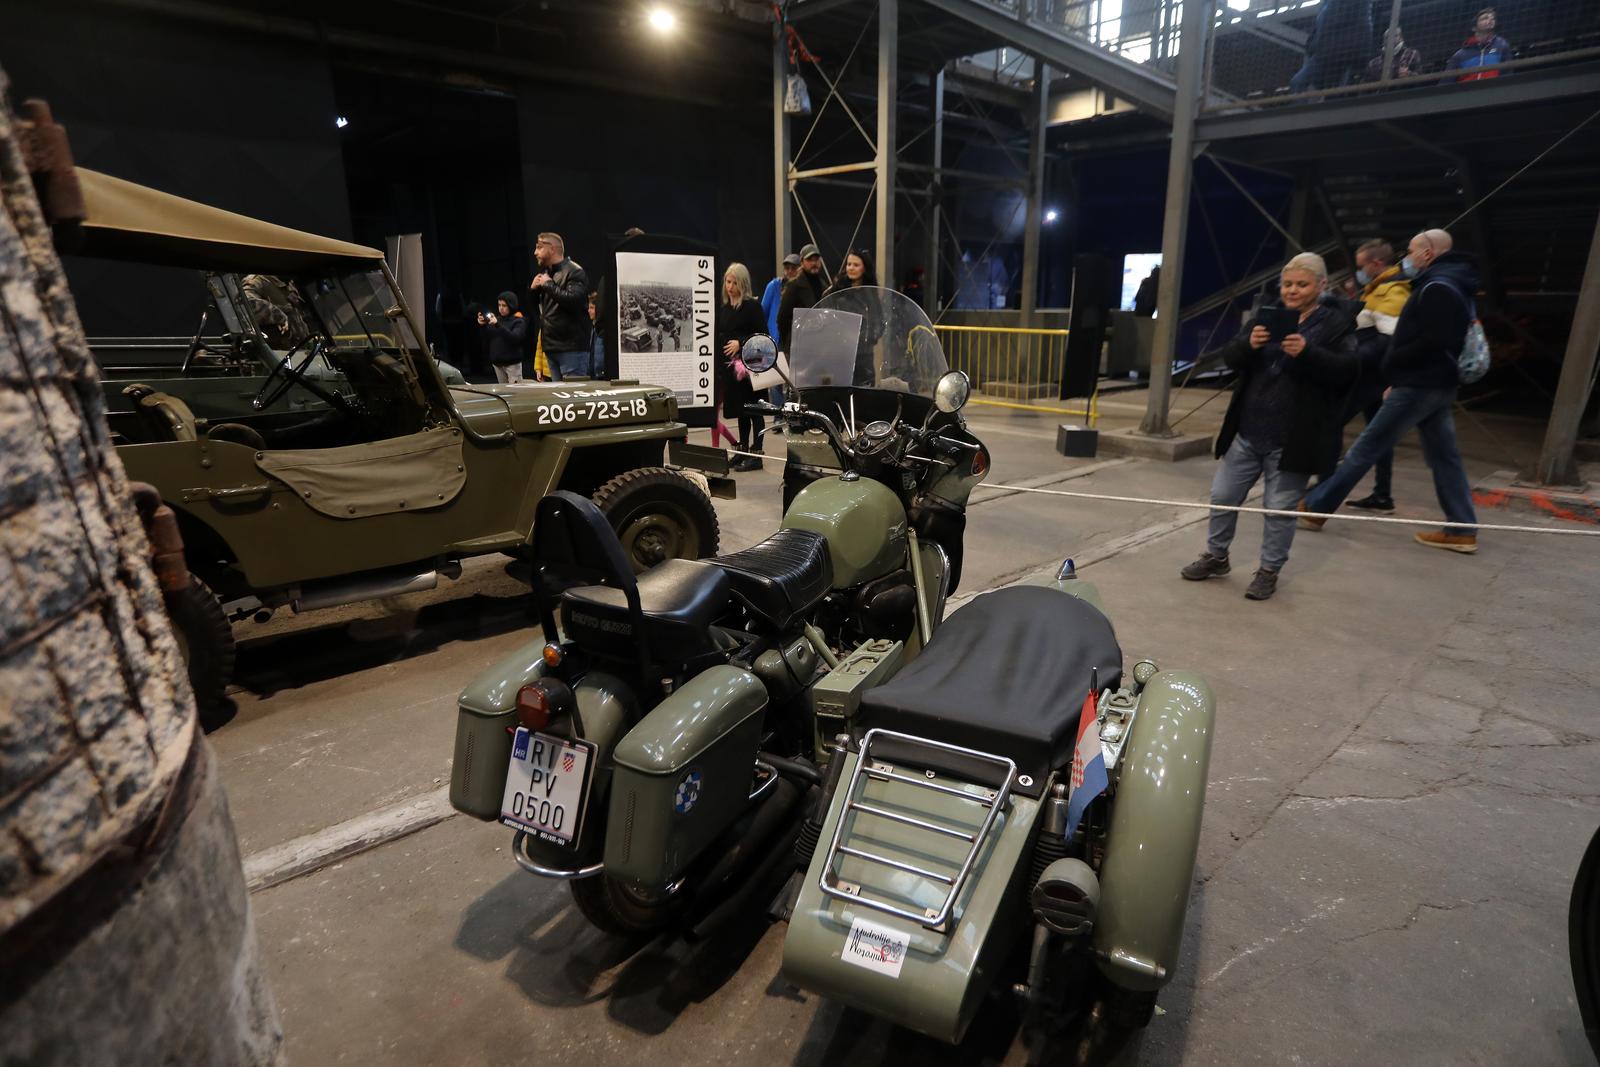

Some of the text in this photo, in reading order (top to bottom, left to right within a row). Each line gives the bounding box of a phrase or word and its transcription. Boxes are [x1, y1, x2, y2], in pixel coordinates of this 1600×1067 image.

[537, 398, 648, 424] 206-723-18
[514, 748, 526, 758] HR
[531, 741, 555, 768] RI
[530, 769, 557, 798] PV
[512, 792, 564, 830] 0500
